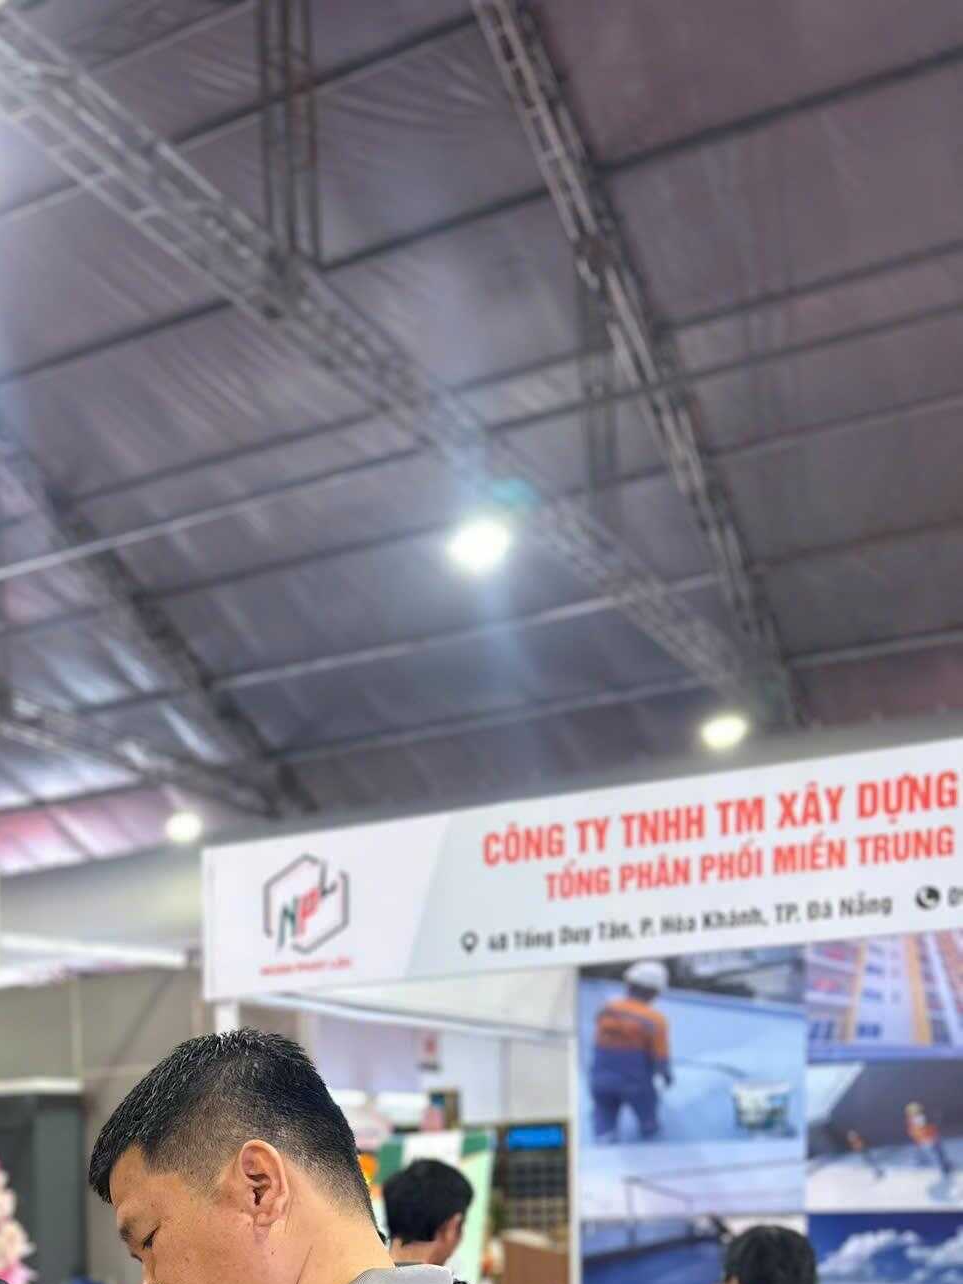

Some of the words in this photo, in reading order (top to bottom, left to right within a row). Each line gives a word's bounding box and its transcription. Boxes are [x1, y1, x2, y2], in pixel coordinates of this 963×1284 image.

[482, 821, 564, 866] CÔNG
[577, 817, 610, 854] TY
[621, 804, 705, 846] TNHH
[716, 797, 766, 835] TM
[777, 780, 844, 829] XÂY
[857, 770, 959, 825] DỰNG
[619, 855, 691, 893] PHÂN
[700, 838, 764, 883] PHỐI
[857, 826, 955, 867] TRUNG
